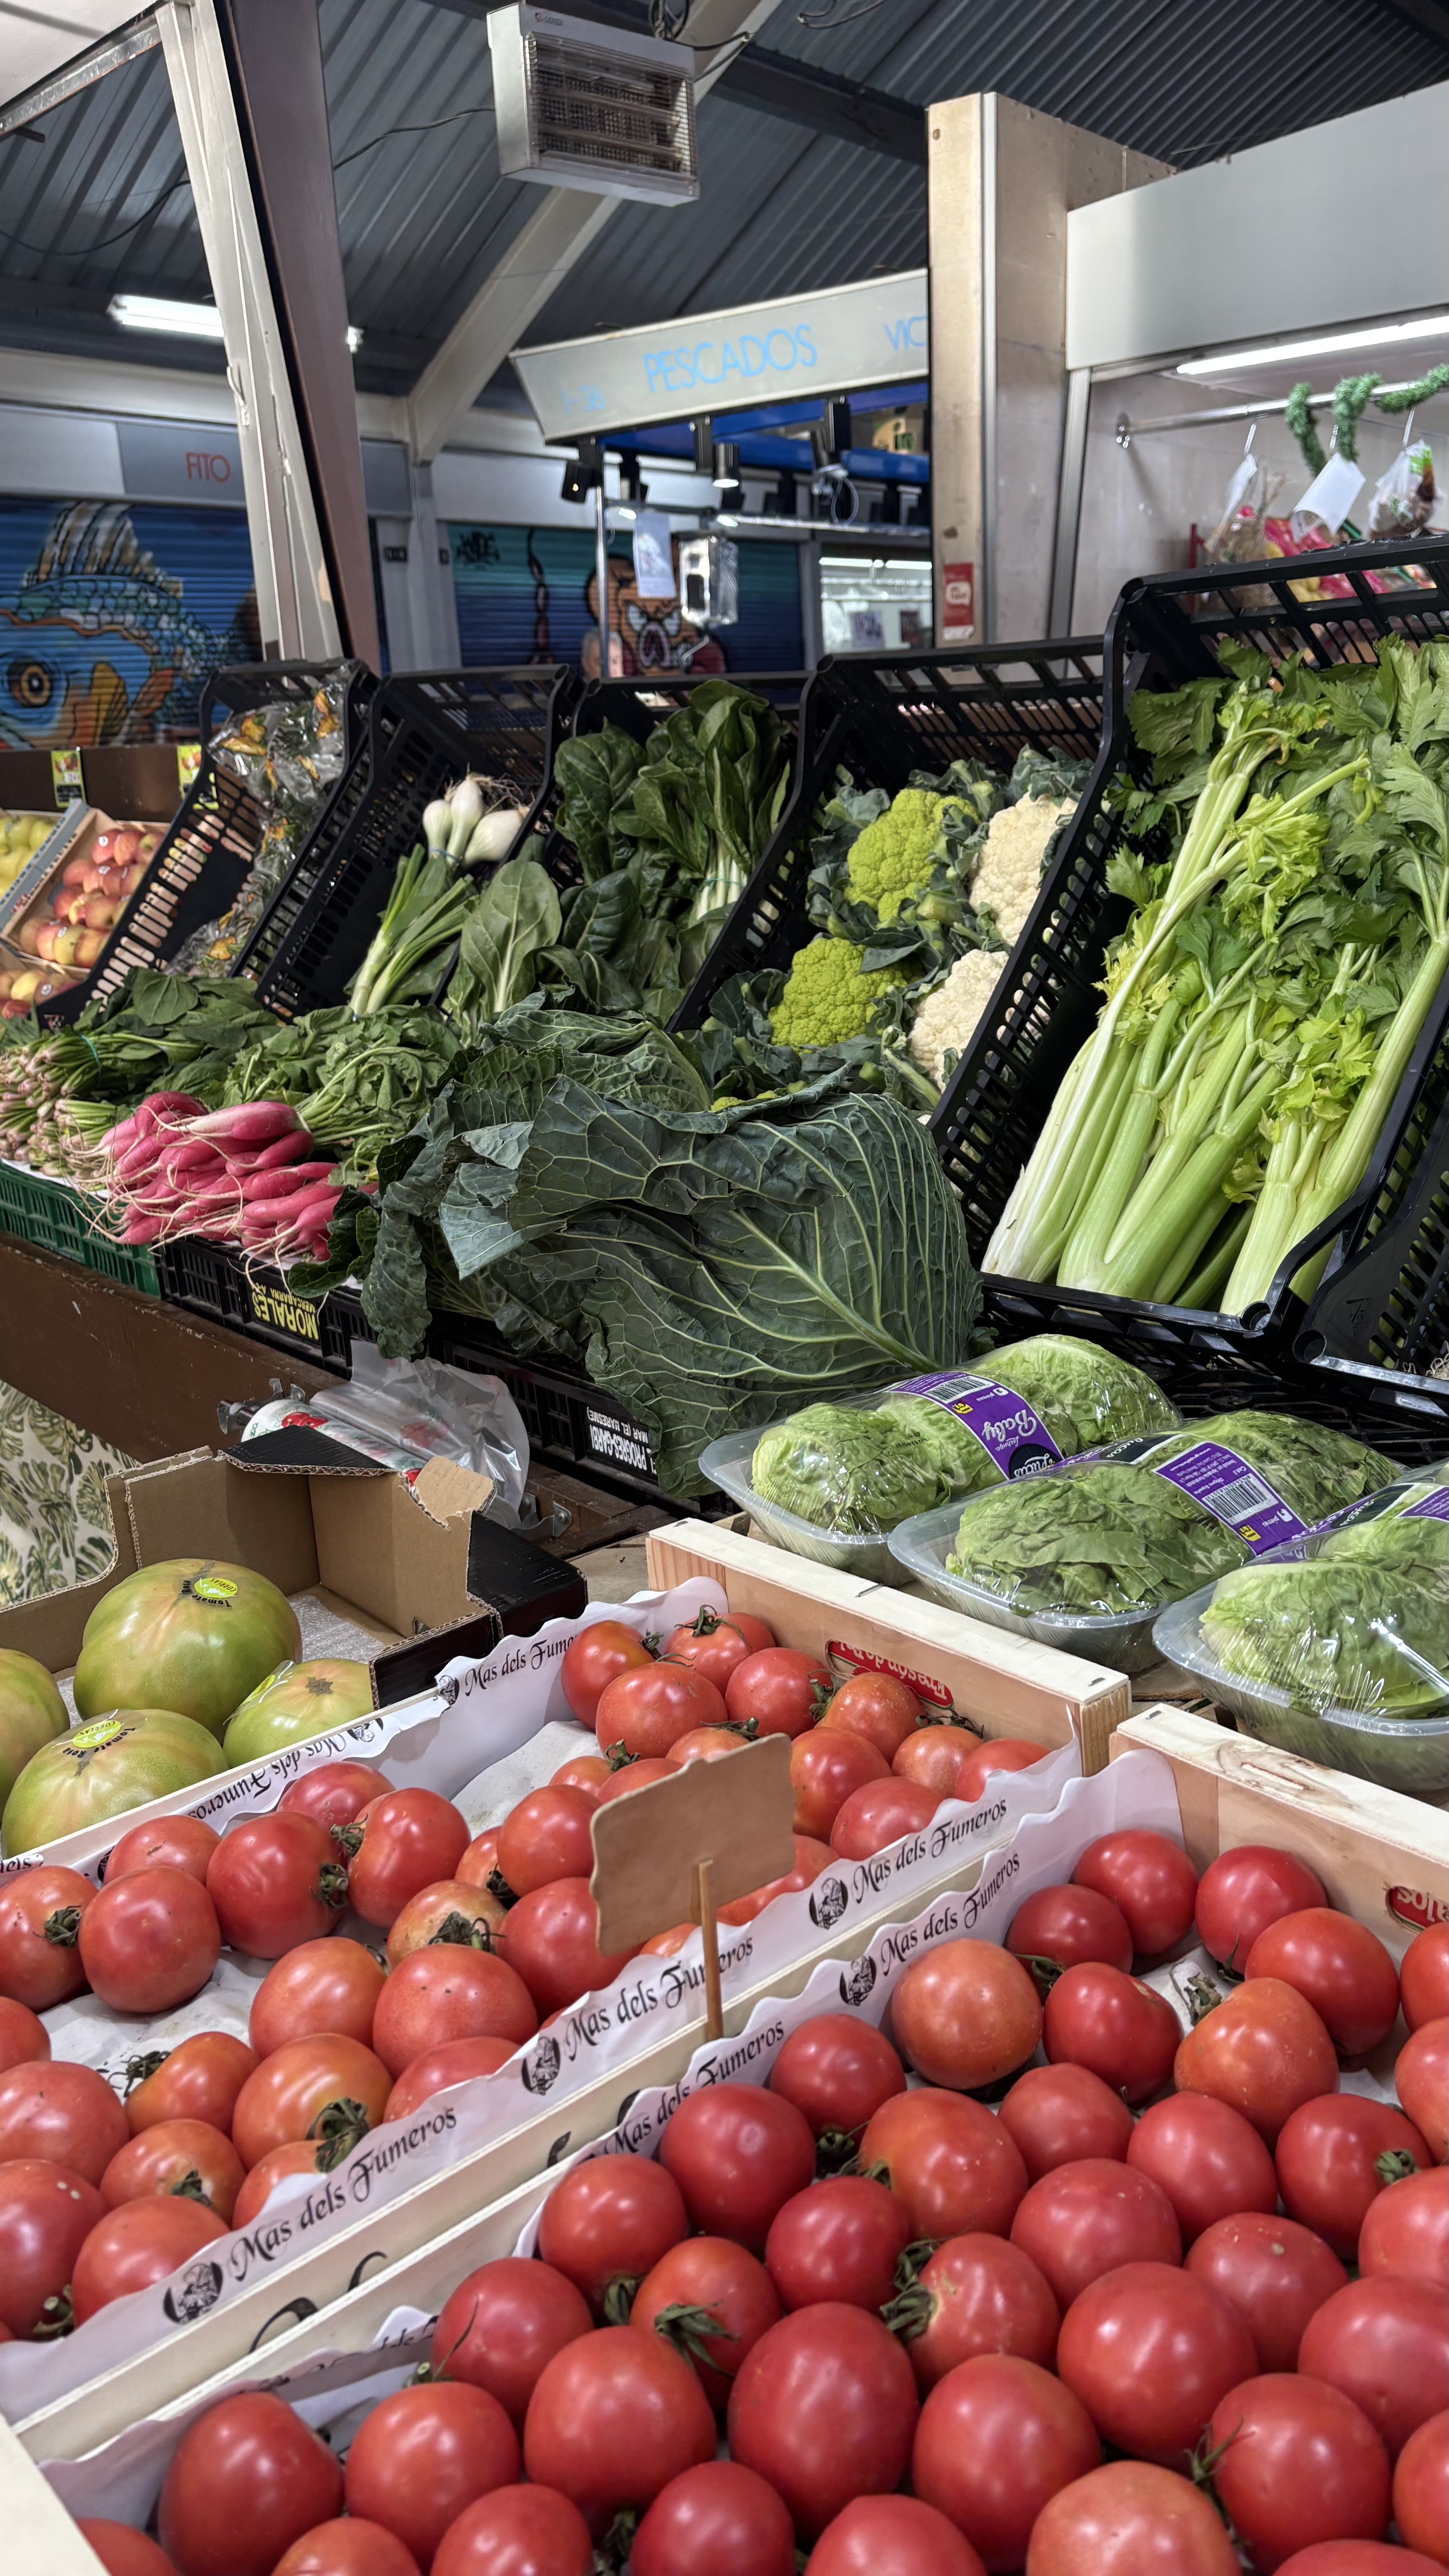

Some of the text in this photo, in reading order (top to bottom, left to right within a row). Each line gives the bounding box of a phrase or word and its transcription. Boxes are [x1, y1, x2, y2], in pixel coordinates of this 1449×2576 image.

[643, 324, 818, 393] PESCADOS
[185, 451, 231, 483] FITO
[252, 1291, 319, 1340] MORALES
[270, 1287, 316, 1314] MERCABARNA
[976, 1392, 995, 1402] piezas
[587, 1406, 620, 1432] MARESME)
[982, 1409, 1037, 1442] Baby
[632, 1427, 649, 1444] MAR
[995, 1435, 1019, 1452] Lechuga
[1262, 1515, 1279, 1527] piezas
[192, 1594, 232, 1607] Tomate
[210, 1578, 237, 1592] CORREAS
[465, 1664, 497, 1697] Mas
[501, 1649, 526, 1676] dels
[80, 1720, 116, 1735] CORREAS
[94, 1727, 136, 1753] Tomate
[188, 1733, 346, 1819] Mas dels Fumeros
[852, 1798, 1007, 1904] Mas dels Fumeros
[881, 1853, 1020, 1976] Mas dels Fumeros
[565, 2002, 611, 2062] Mas
[617, 1979, 658, 2024] dels
[605, 2021, 784, 2155] Mas dels Fumeros
[230, 2105, 458, 2282] Mas dels Fumeros
